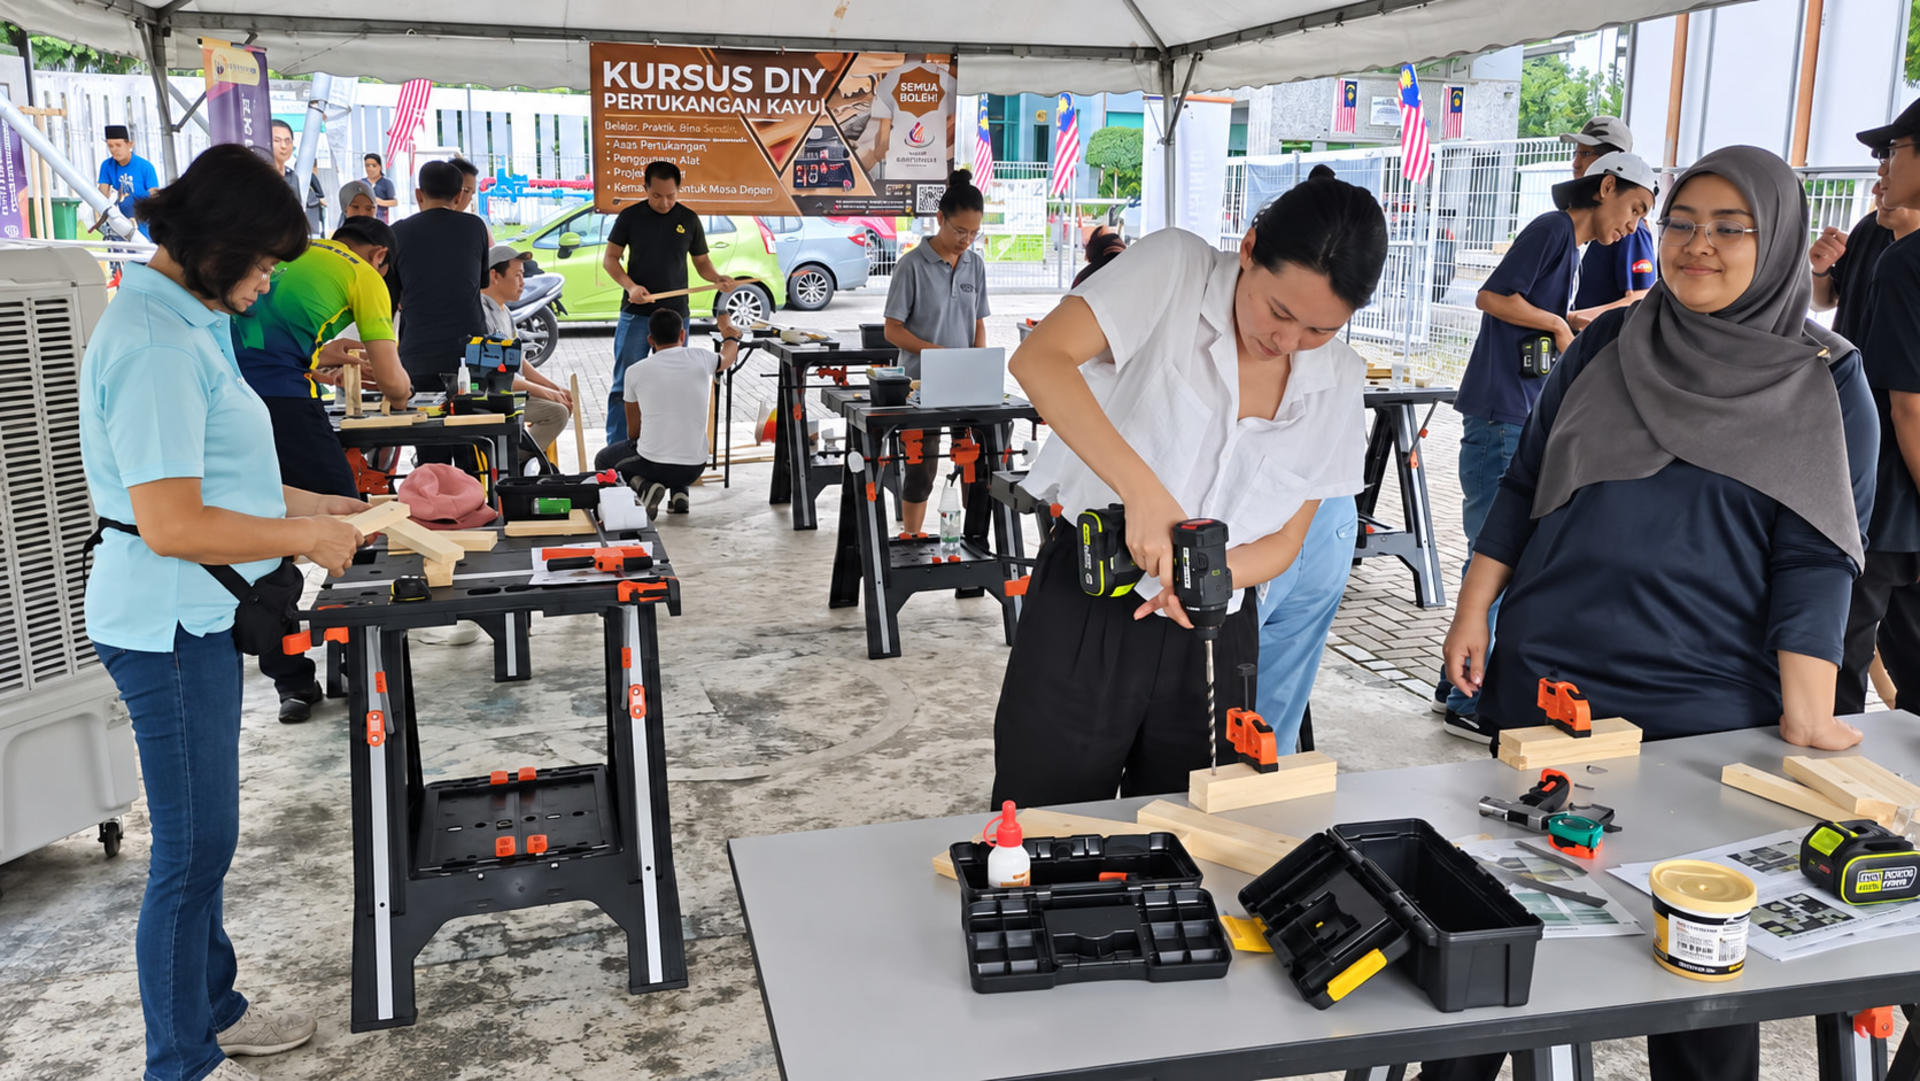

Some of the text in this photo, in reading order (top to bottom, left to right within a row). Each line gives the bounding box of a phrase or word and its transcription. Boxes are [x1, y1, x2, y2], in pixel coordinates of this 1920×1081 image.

[603, 61, 826, 94] KURSUS DIY
[901, 82, 939, 92] SEMUA
[604, 92, 761, 115] PERTUKANGAN
[679, 155, 700, 165] Alat
